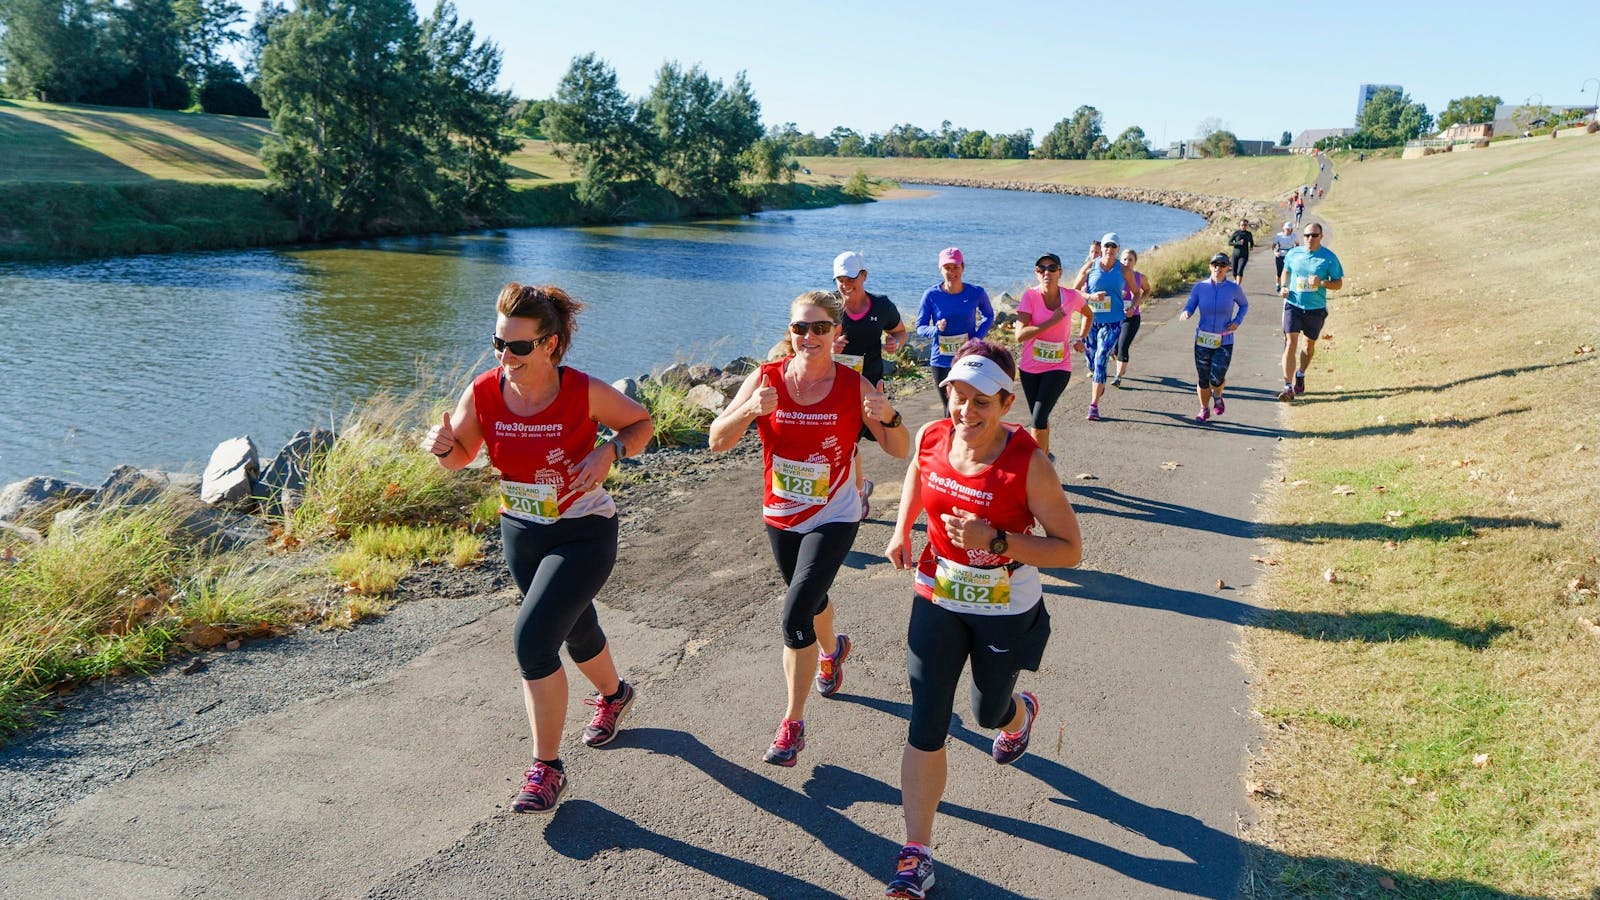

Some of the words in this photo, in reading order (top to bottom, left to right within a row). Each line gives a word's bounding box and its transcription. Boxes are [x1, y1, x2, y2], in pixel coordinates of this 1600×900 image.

[776, 409, 838, 420] five30runners
[495, 421, 563, 432] five30runners
[783, 476, 813, 495] 128
[929, 471, 993, 501] five30runners
[510, 497, 541, 515] 201
[951, 582, 990, 603] 162
